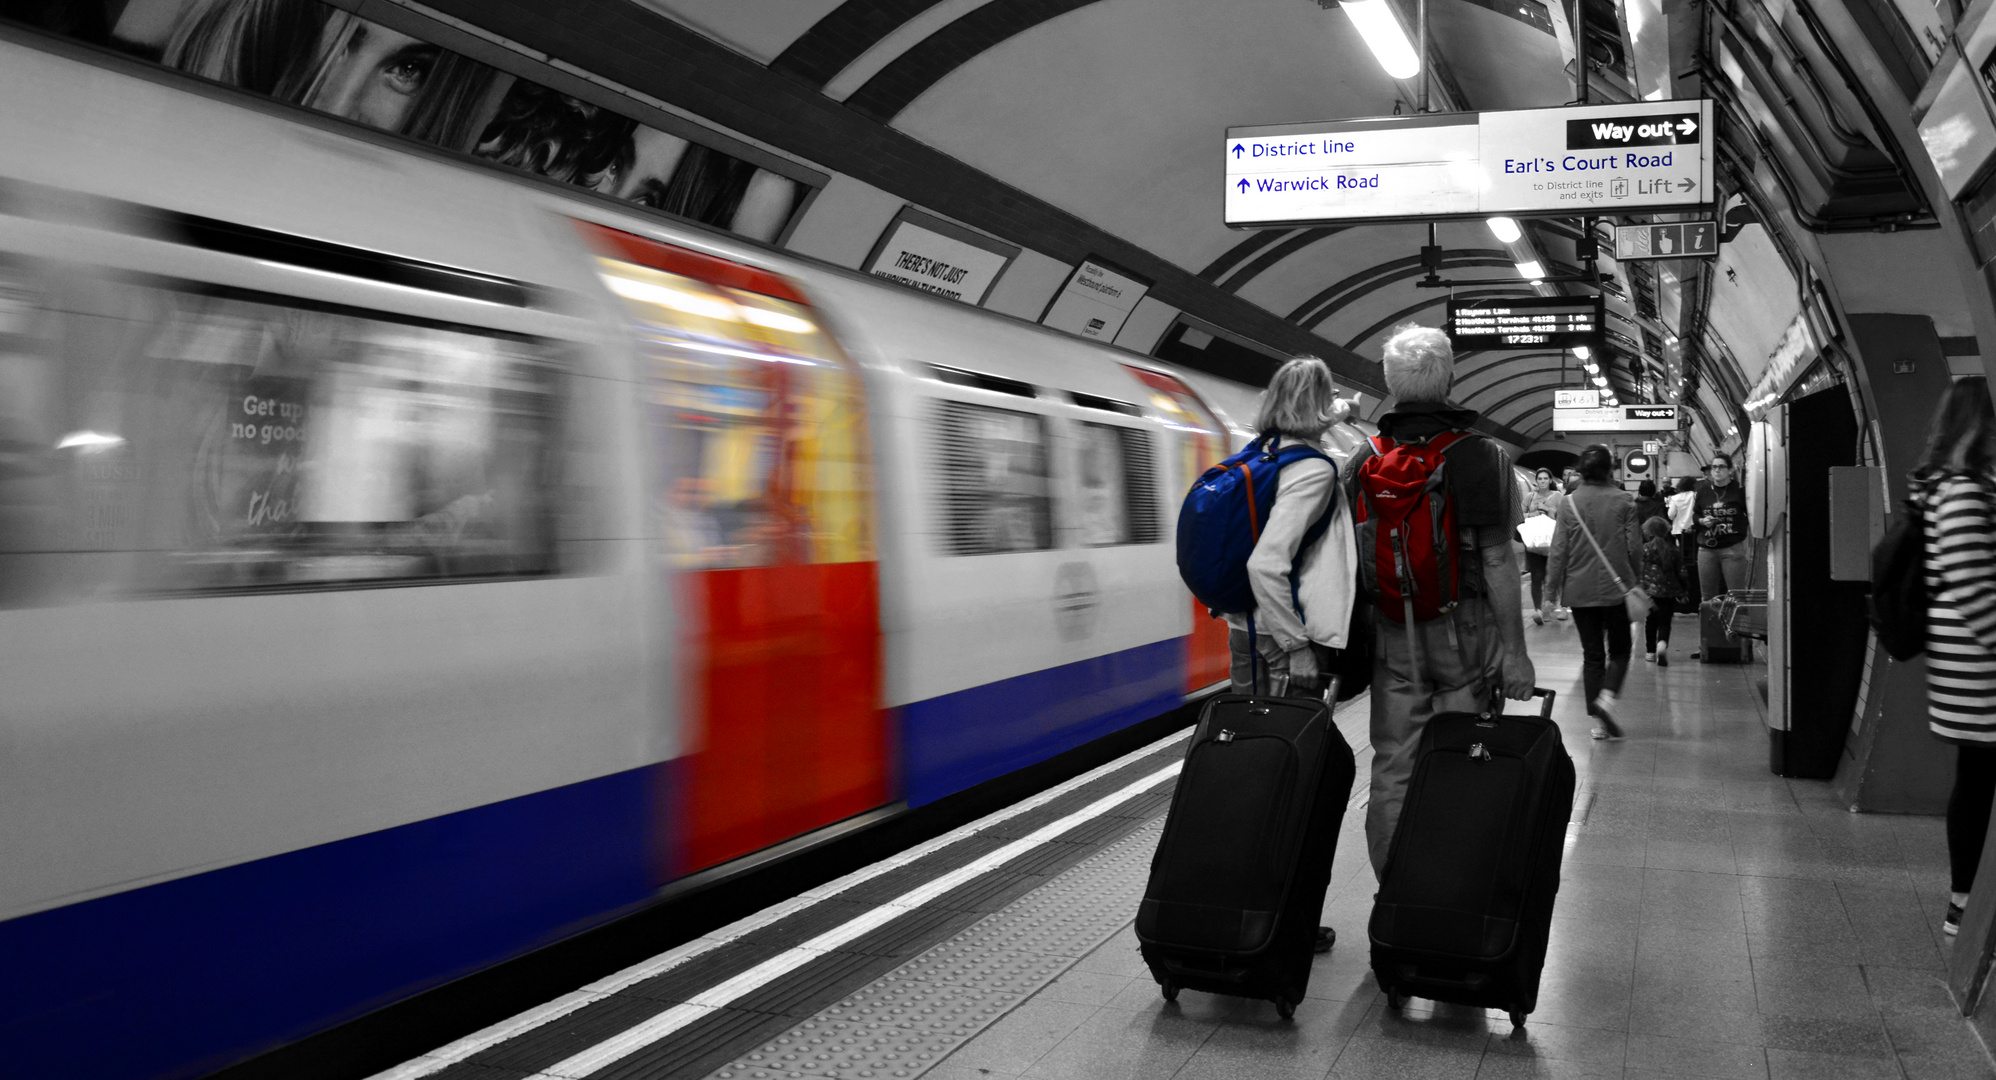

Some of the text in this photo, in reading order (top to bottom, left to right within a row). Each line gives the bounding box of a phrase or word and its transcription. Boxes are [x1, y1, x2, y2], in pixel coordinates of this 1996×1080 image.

[1592, 121, 1673, 142] Way out
[1252, 140, 1355, 157] District line
[1505, 152, 1673, 174] Earl's Court Road
[1256, 174, 1379, 192] Warwick Road
[1533, 180, 1604, 191] to District line
[1638, 178, 1673, 194] Lift
[1559, 190, 1604, 200] and exits
[895, 251, 933, 275] THERE'S
[927, 261, 950, 279] NOT
[942, 266, 969, 285] JUST
[1493, 307, 1511, 315] Lane
[1462, 317, 1495, 325] Heathrow
[1462, 326, 1495, 334] Heathrow
[243, 395, 276, 416] Get
[1634, 409, 1666, 418] Way out
[232, 422, 257, 439] no
